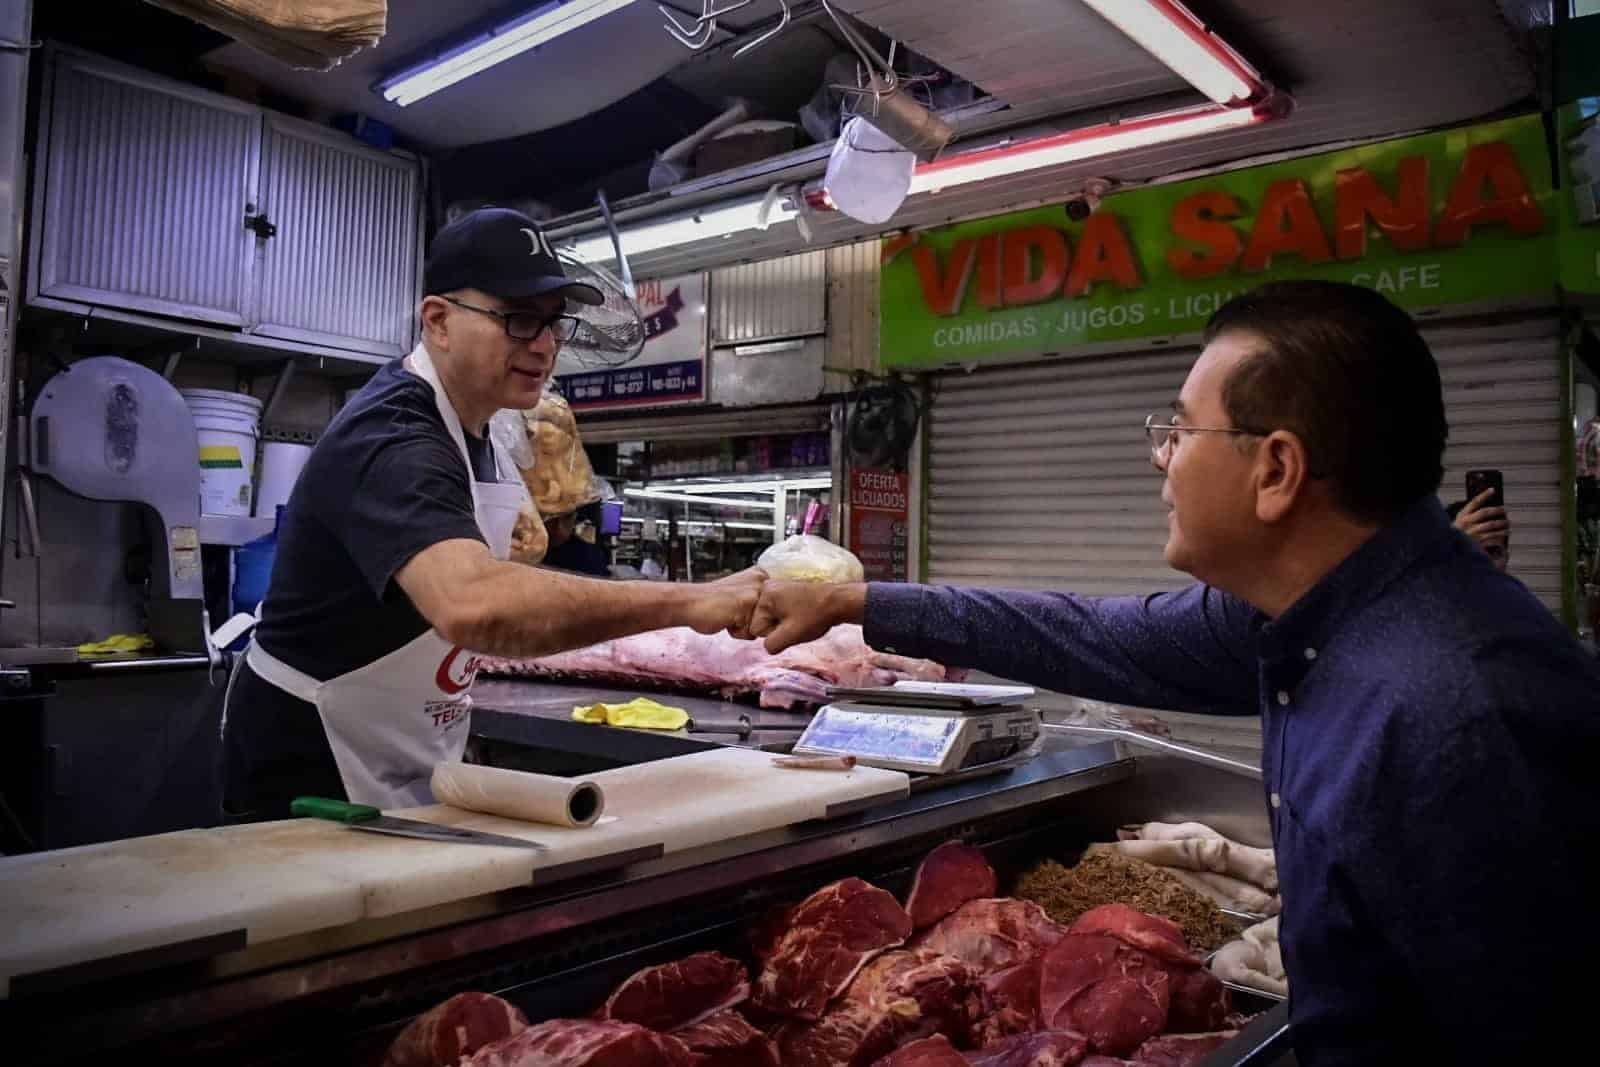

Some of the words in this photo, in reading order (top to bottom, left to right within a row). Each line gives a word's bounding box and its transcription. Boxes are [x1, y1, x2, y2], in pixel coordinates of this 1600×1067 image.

[912, 213, 1141, 315] VIDA
[1169, 141, 1543, 279] SANA
[932, 317, 1038, 349] COMIDAS
[1056, 301, 1146, 332] JUGOS
[1168, 288, 1234, 320] LICU
[852, 490, 906, 508] LICUADOS
[858, 472, 899, 490] OFERTA
